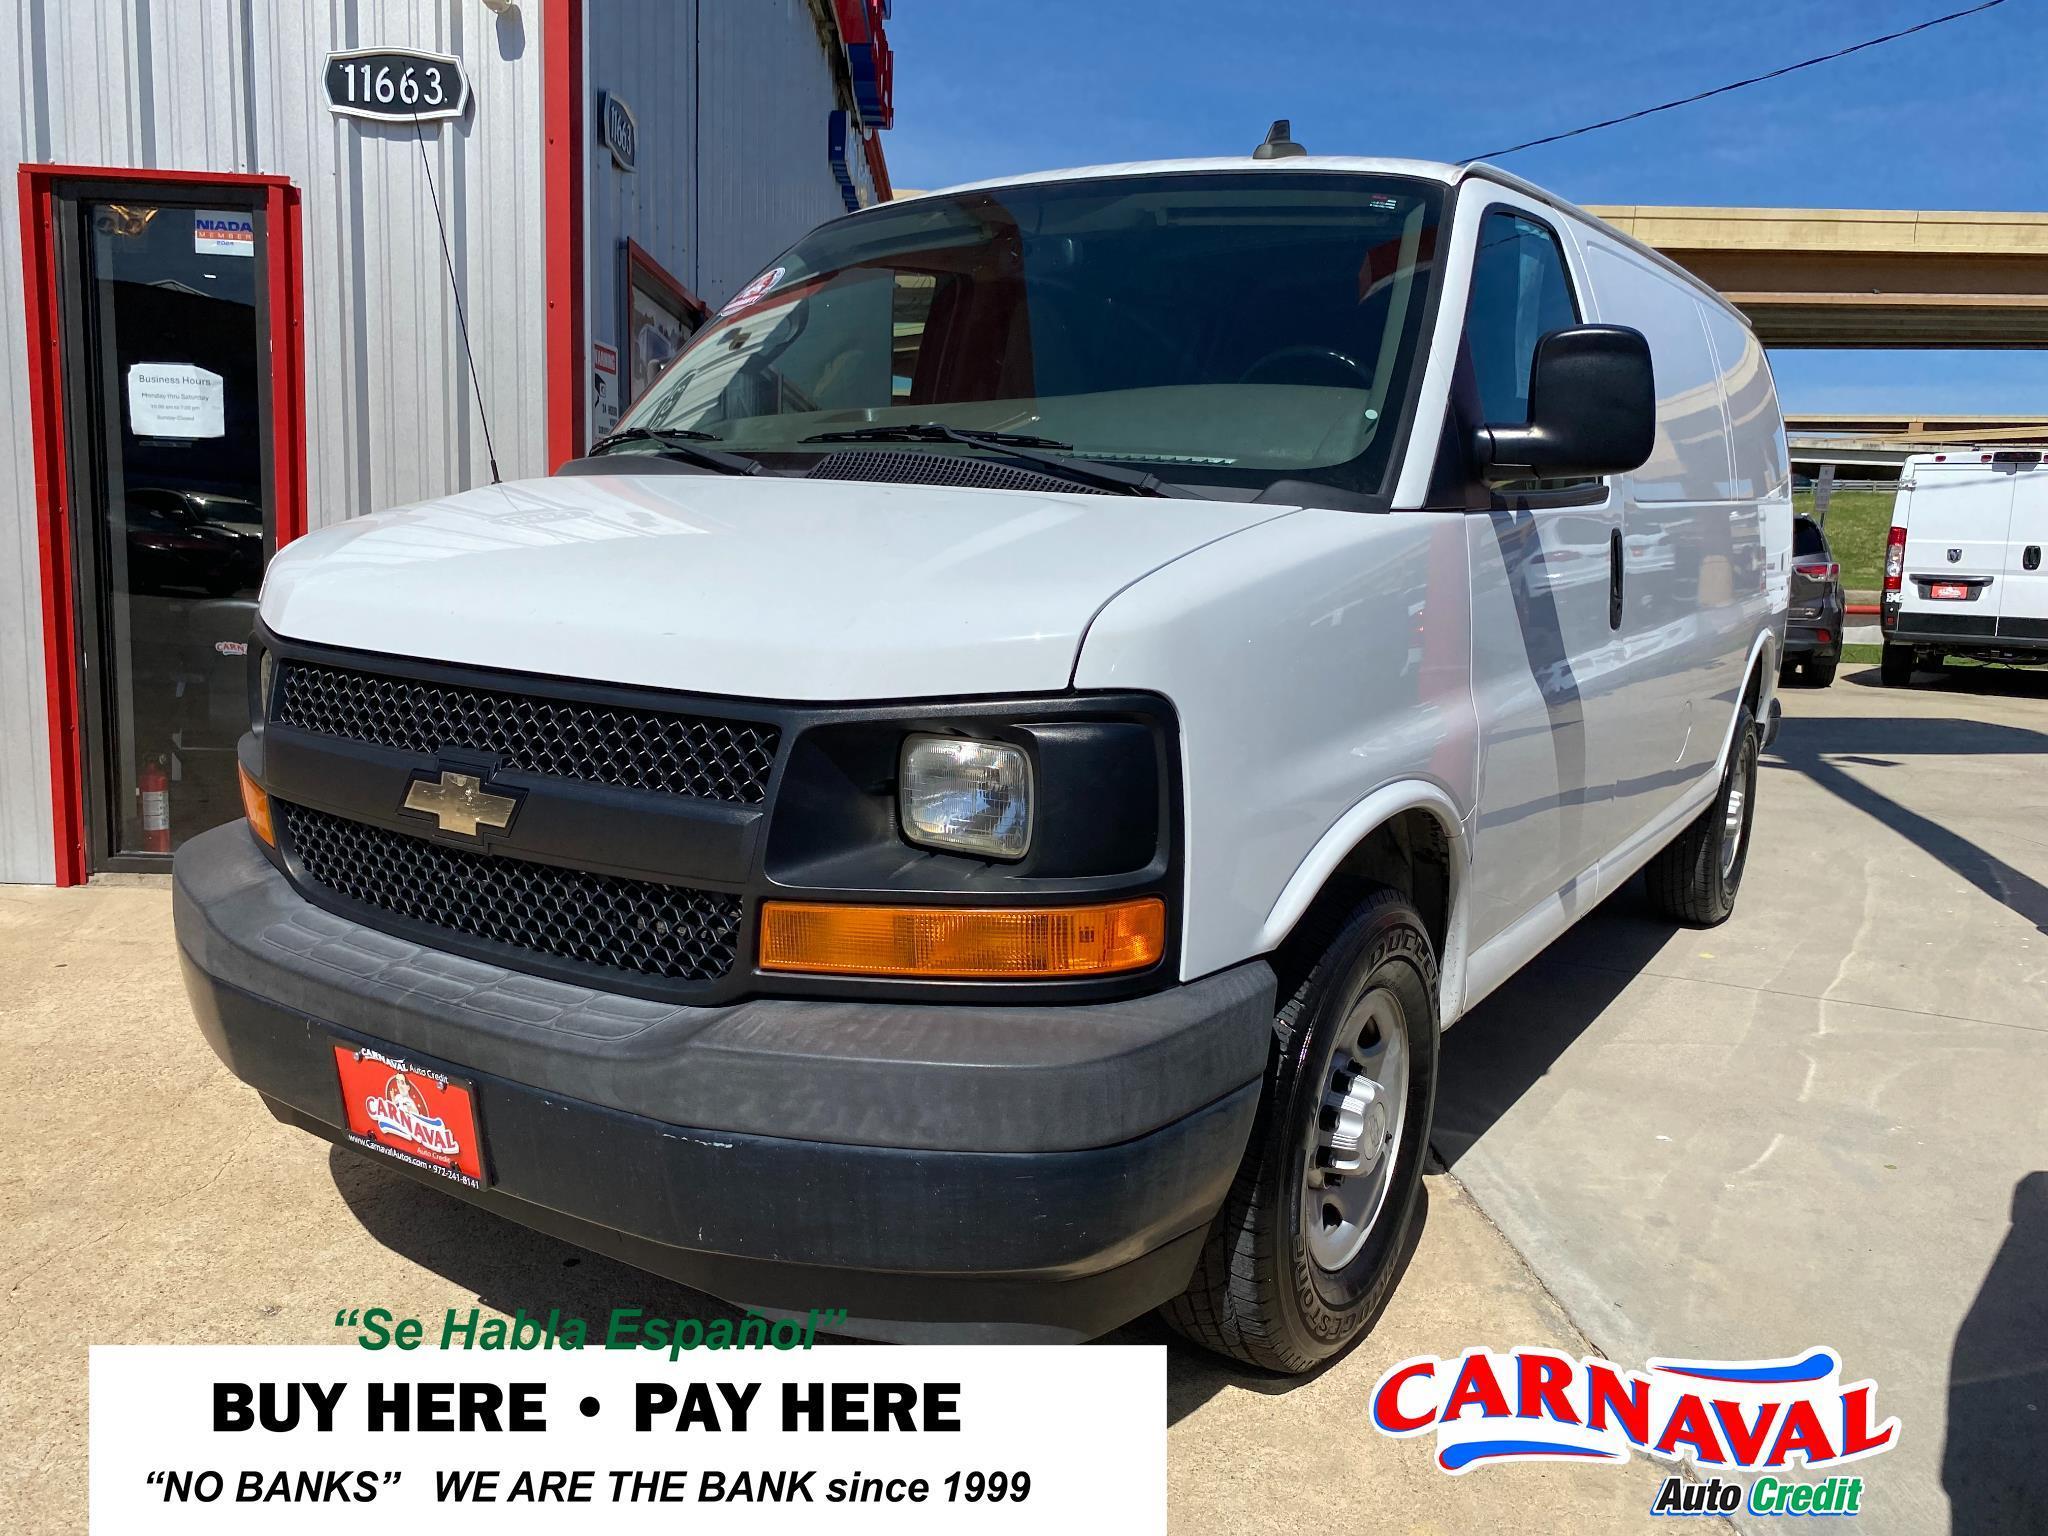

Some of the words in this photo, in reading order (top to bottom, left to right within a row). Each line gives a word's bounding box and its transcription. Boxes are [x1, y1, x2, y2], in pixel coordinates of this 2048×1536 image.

[344, 64, 443, 105] 11663
[611, 106, 631, 156] 11663
[196, 219, 252, 232] NIADA
[198, 231, 252, 240] MEMBER
[139, 375, 180, 384] Business
[182, 376, 211, 386] Hours
[141, 392, 166, 400] Monday
[180, 393, 209, 402] Saturday
[361, 1047, 408, 1072] CARNAVAL
[409, 1063, 426, 1077] Auto
[427, 1069, 448, 1083] Credit
[366, 1097, 457, 1149] CARNAVAL
[348, 1133, 428, 1170] www.CarnavalAutos.com
[417, 1146, 431, 1157] Auto
